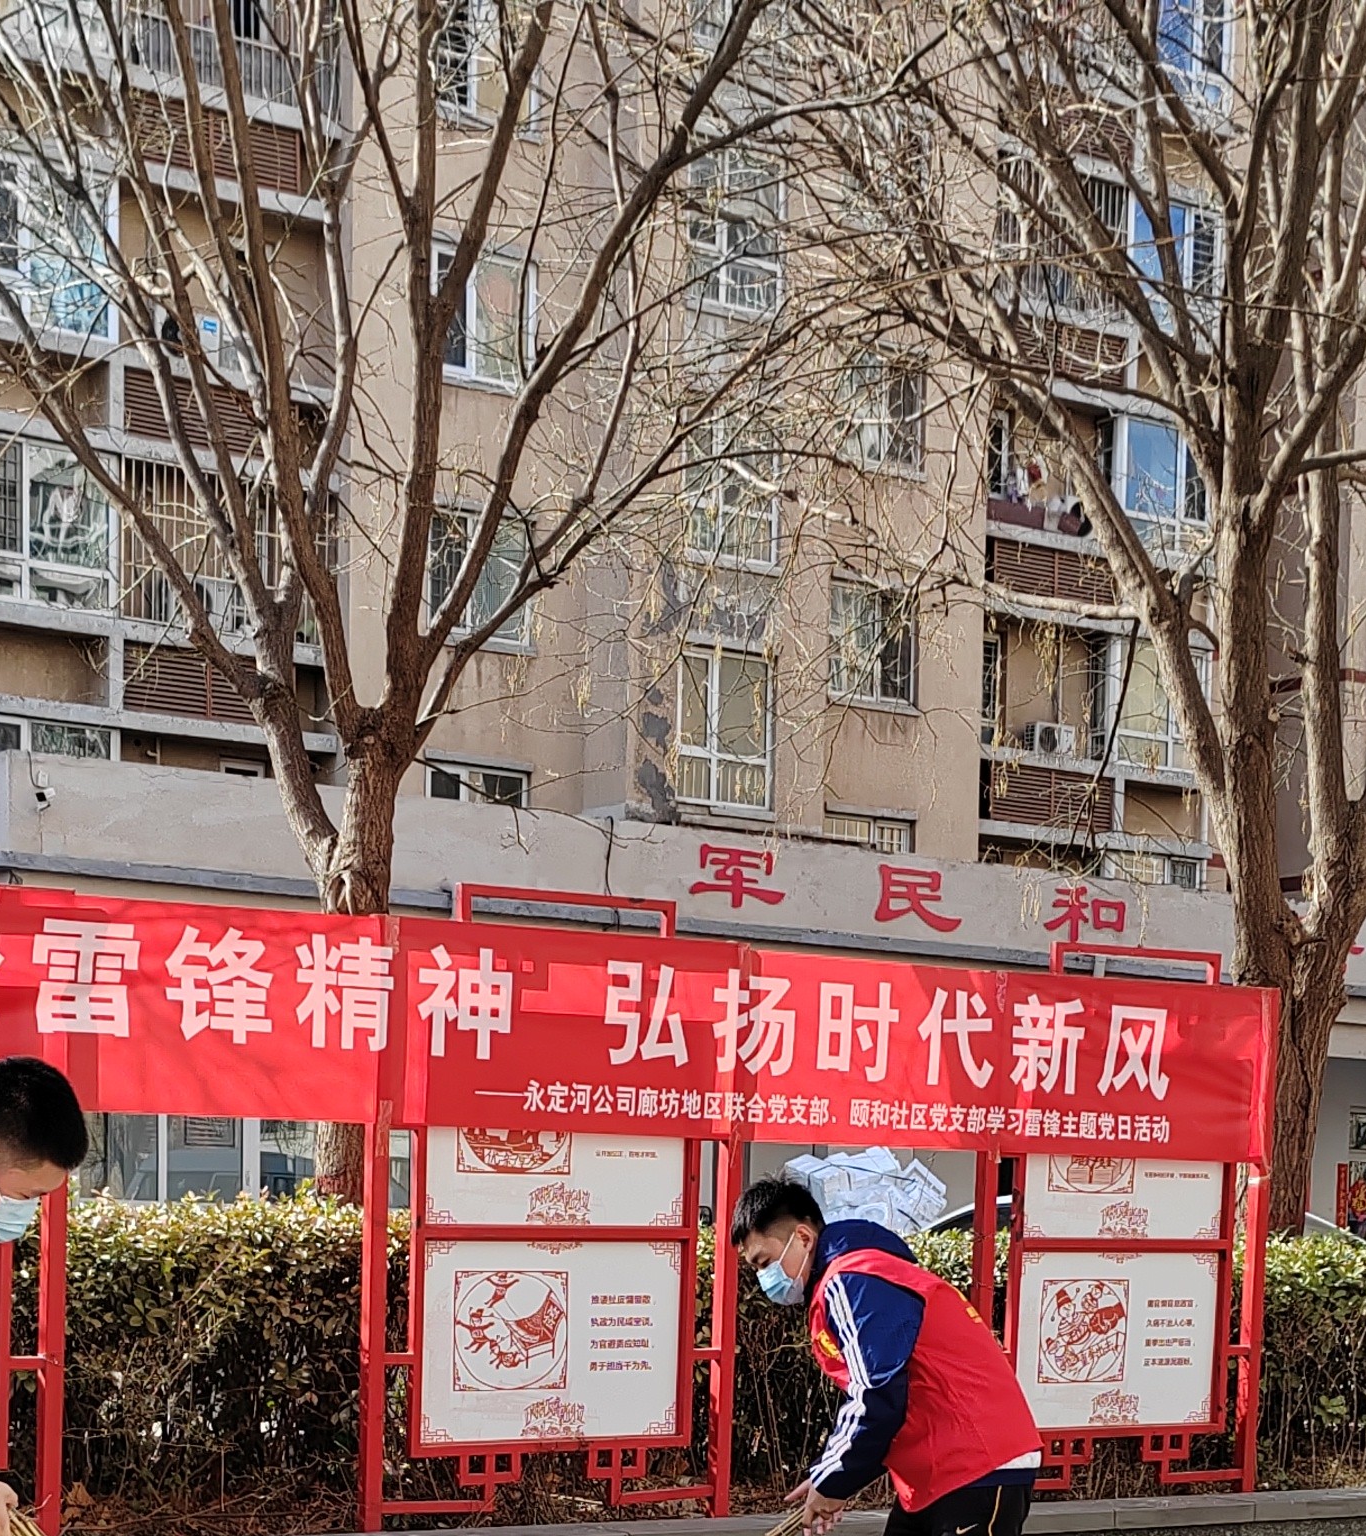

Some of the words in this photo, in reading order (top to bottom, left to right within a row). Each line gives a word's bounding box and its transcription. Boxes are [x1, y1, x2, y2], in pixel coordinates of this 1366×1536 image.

[688, 843, 1127, 943] 军民和
[605, 959, 1171, 1101] 弘扬时代新风
